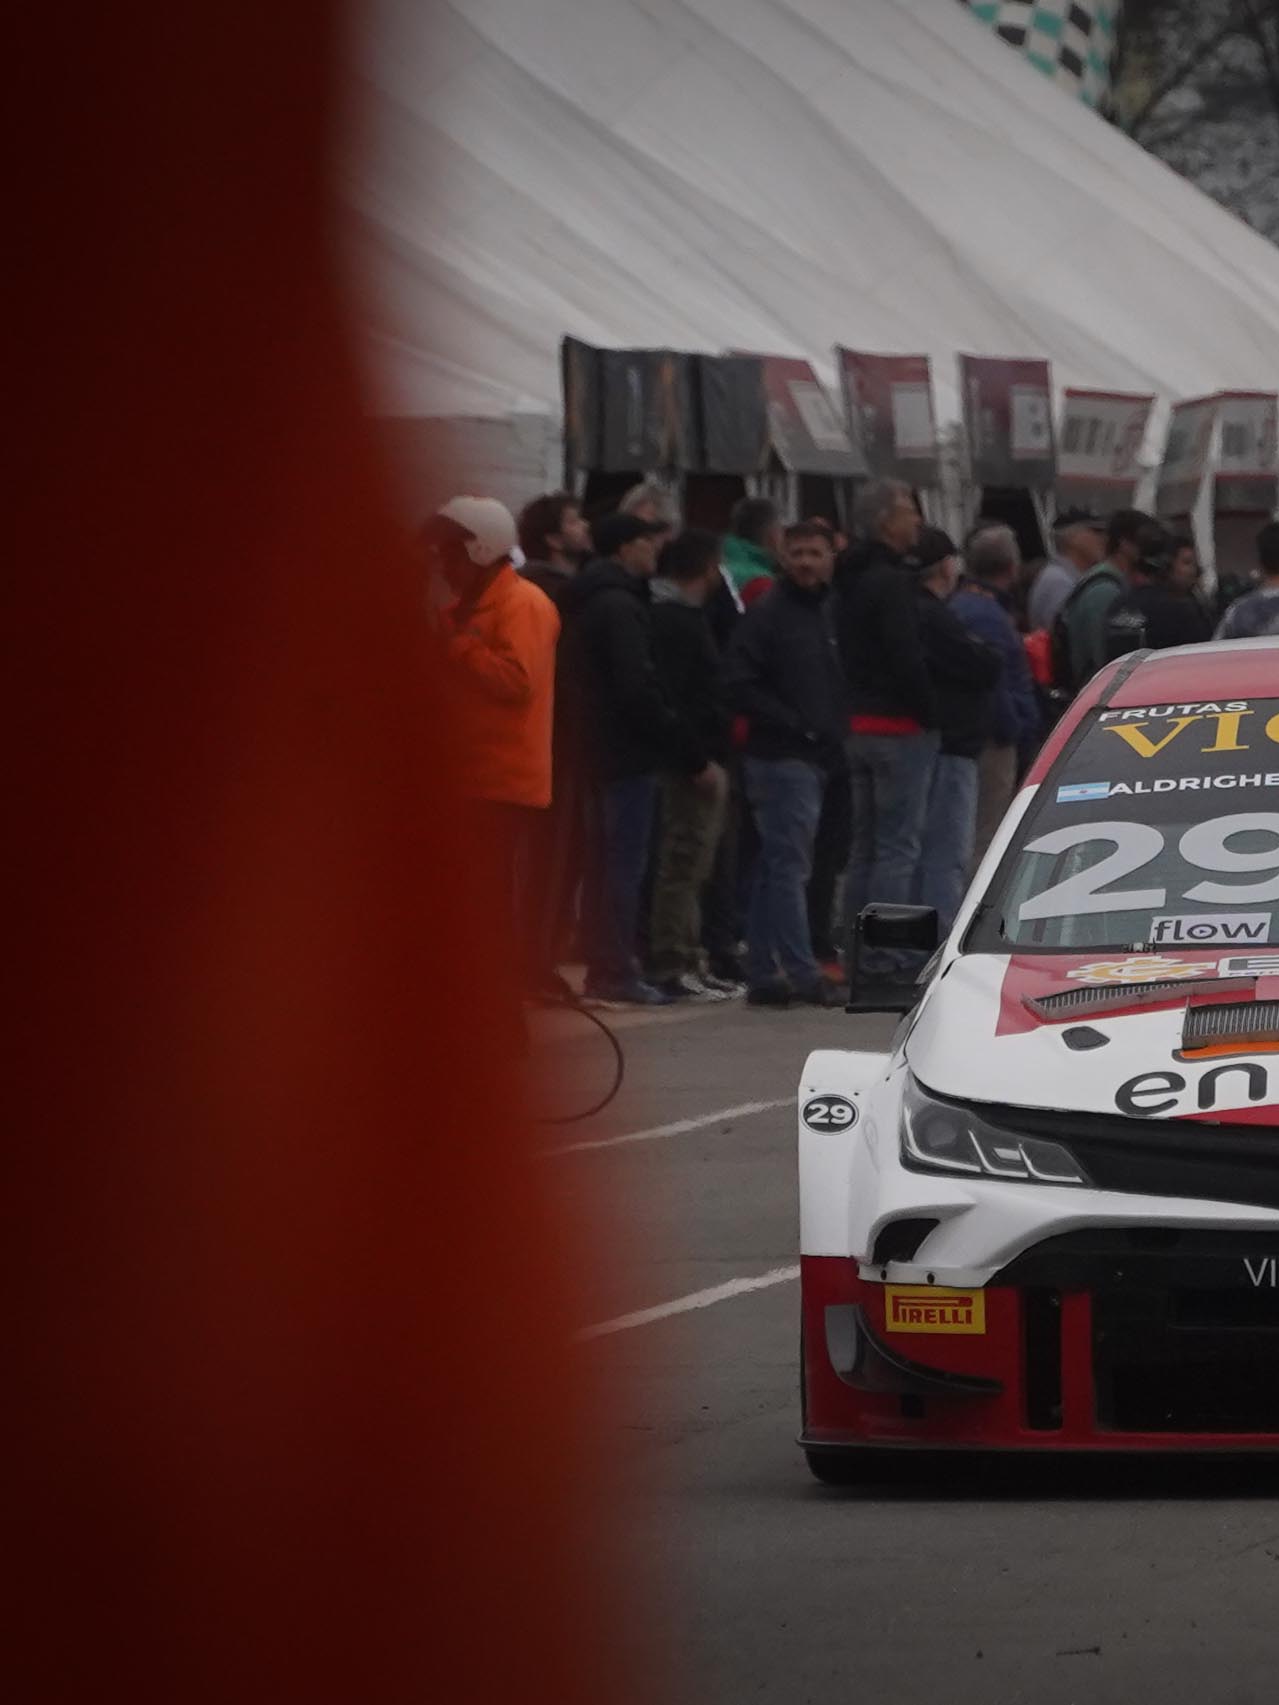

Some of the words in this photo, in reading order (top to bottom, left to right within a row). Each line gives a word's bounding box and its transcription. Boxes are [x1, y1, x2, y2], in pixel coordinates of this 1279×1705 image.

[1100, 701, 1249, 721] FRUTAS
[1154, 920, 1266, 942] flow
[807, 1104, 853, 1124] 29
[891, 1296, 973, 1324] PIRELLI
